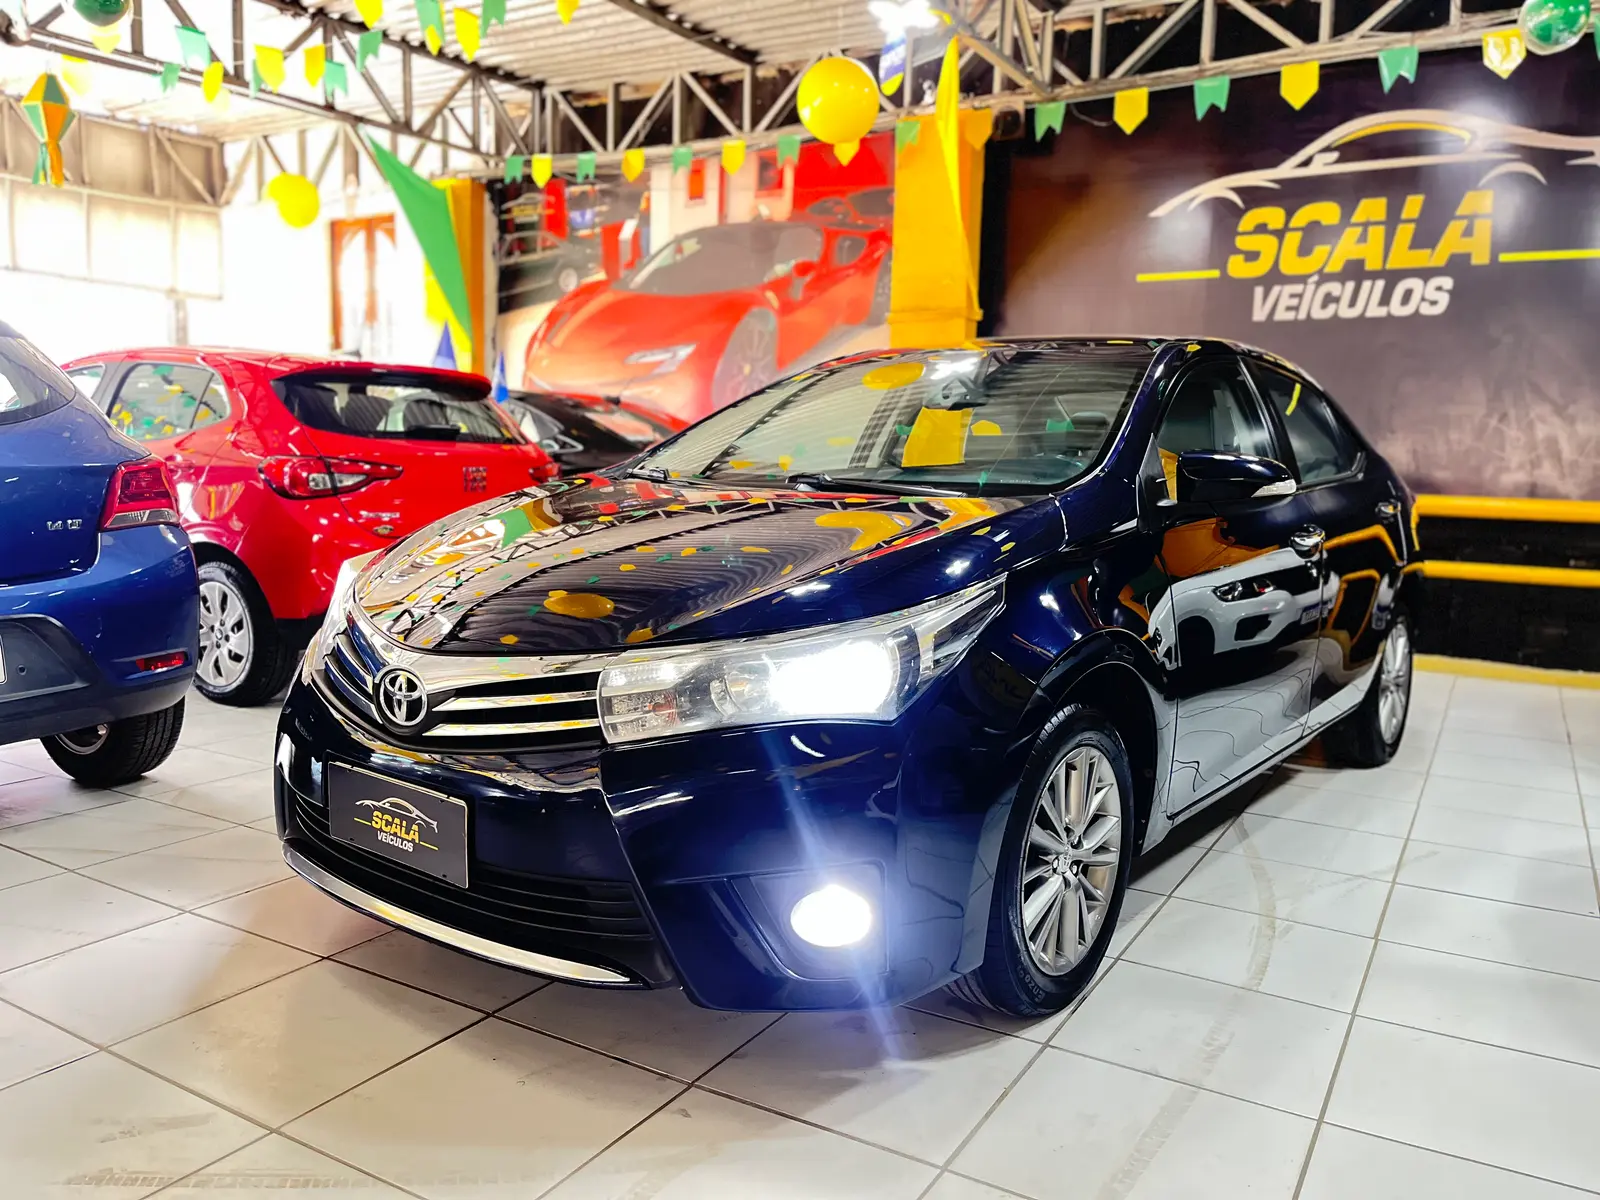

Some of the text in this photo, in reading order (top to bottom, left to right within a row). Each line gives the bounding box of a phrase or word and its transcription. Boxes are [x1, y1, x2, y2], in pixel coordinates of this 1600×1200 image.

[1226, 189, 1494, 279] SCALA
[1251, 274, 1454, 322] VEÍCULOS
[371, 810, 420, 844] SCALA
[377, 830, 414, 853] VEÍCULOS
